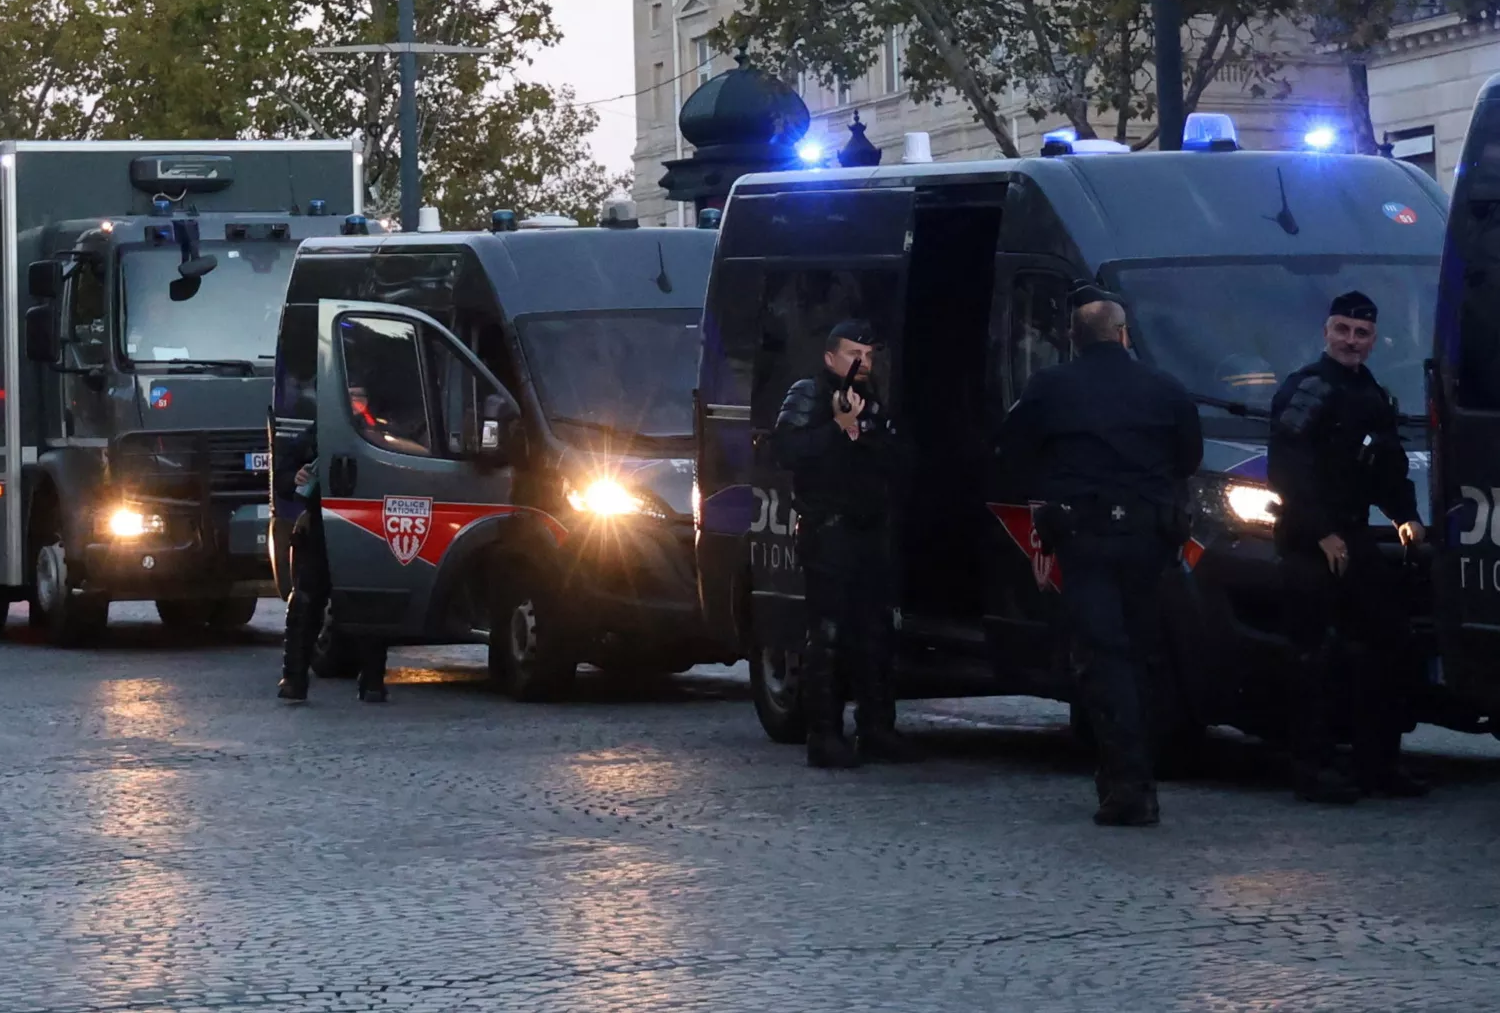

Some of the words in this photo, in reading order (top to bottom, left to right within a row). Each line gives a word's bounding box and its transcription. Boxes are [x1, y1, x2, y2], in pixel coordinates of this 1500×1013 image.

[391, 500, 425, 508] POLICE
[387, 507, 427, 515] NATIONALE
[387, 516, 426, 535] CRS
